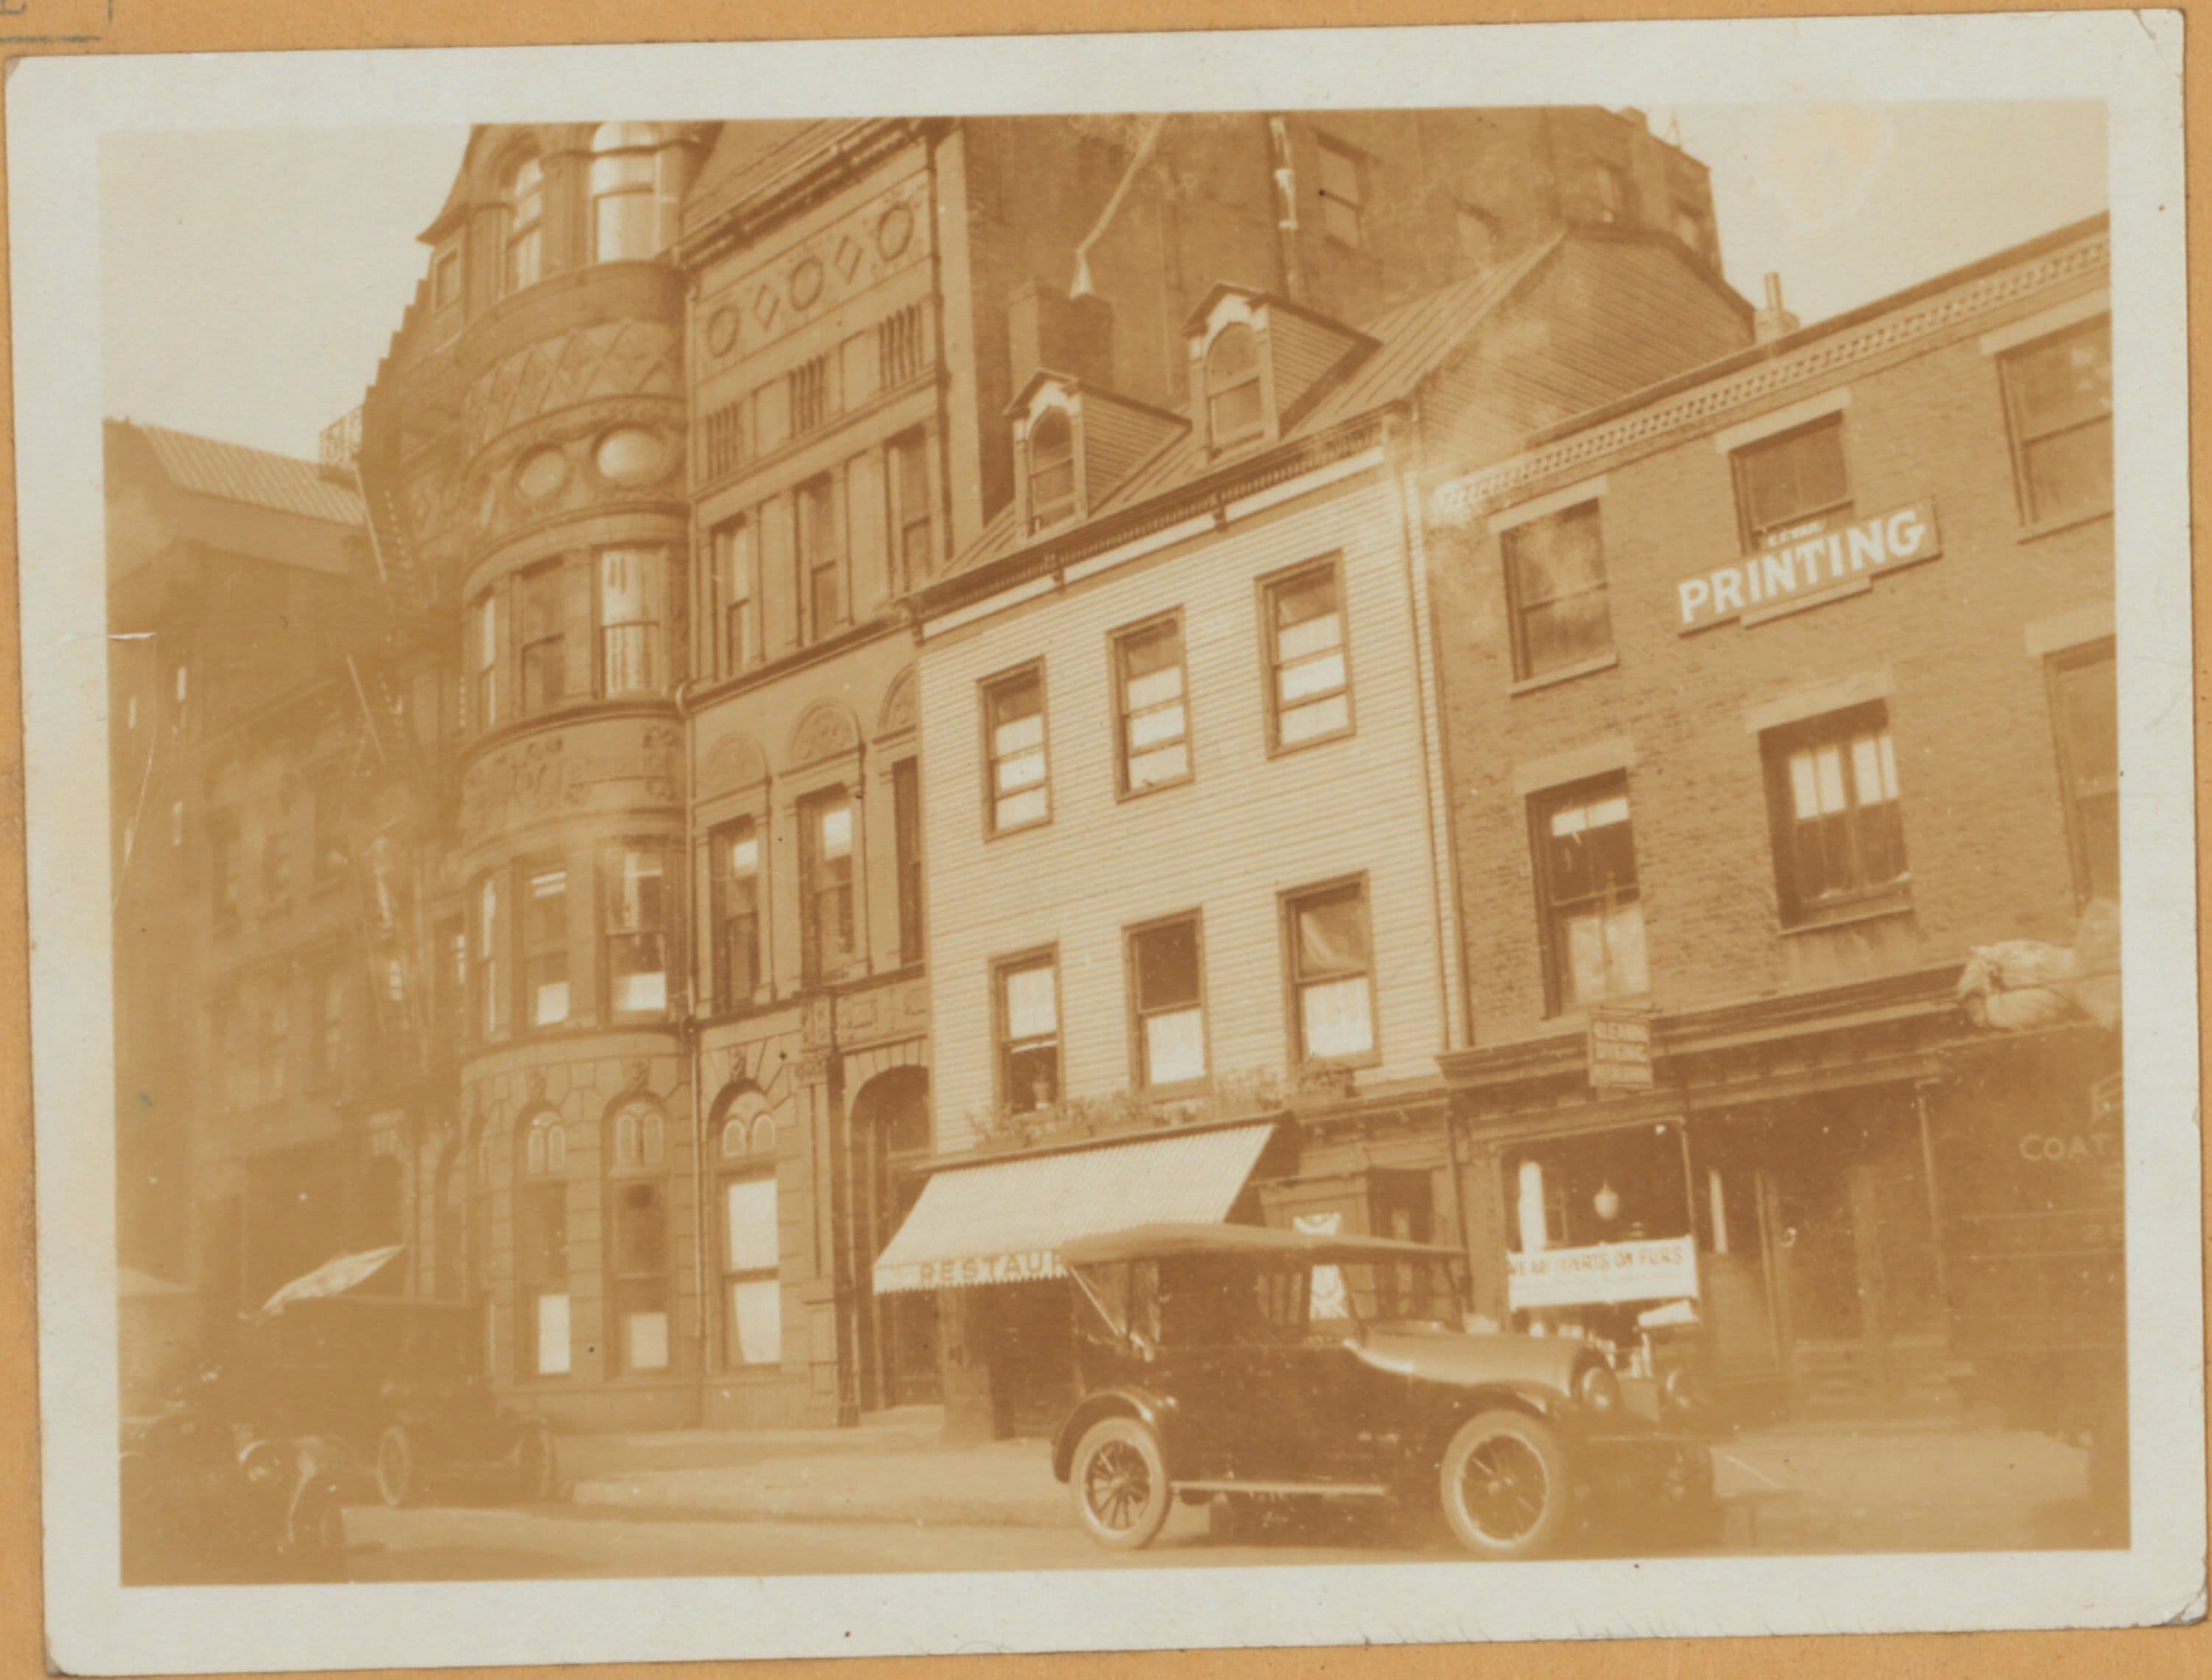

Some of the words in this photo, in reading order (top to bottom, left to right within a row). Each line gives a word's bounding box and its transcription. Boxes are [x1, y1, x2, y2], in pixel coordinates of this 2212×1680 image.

[1677, 510, 1926, 624] PRINTING
[2018, 1133, 2112, 1162] COAT
[1639, 1245, 1684, 1266] FURS
